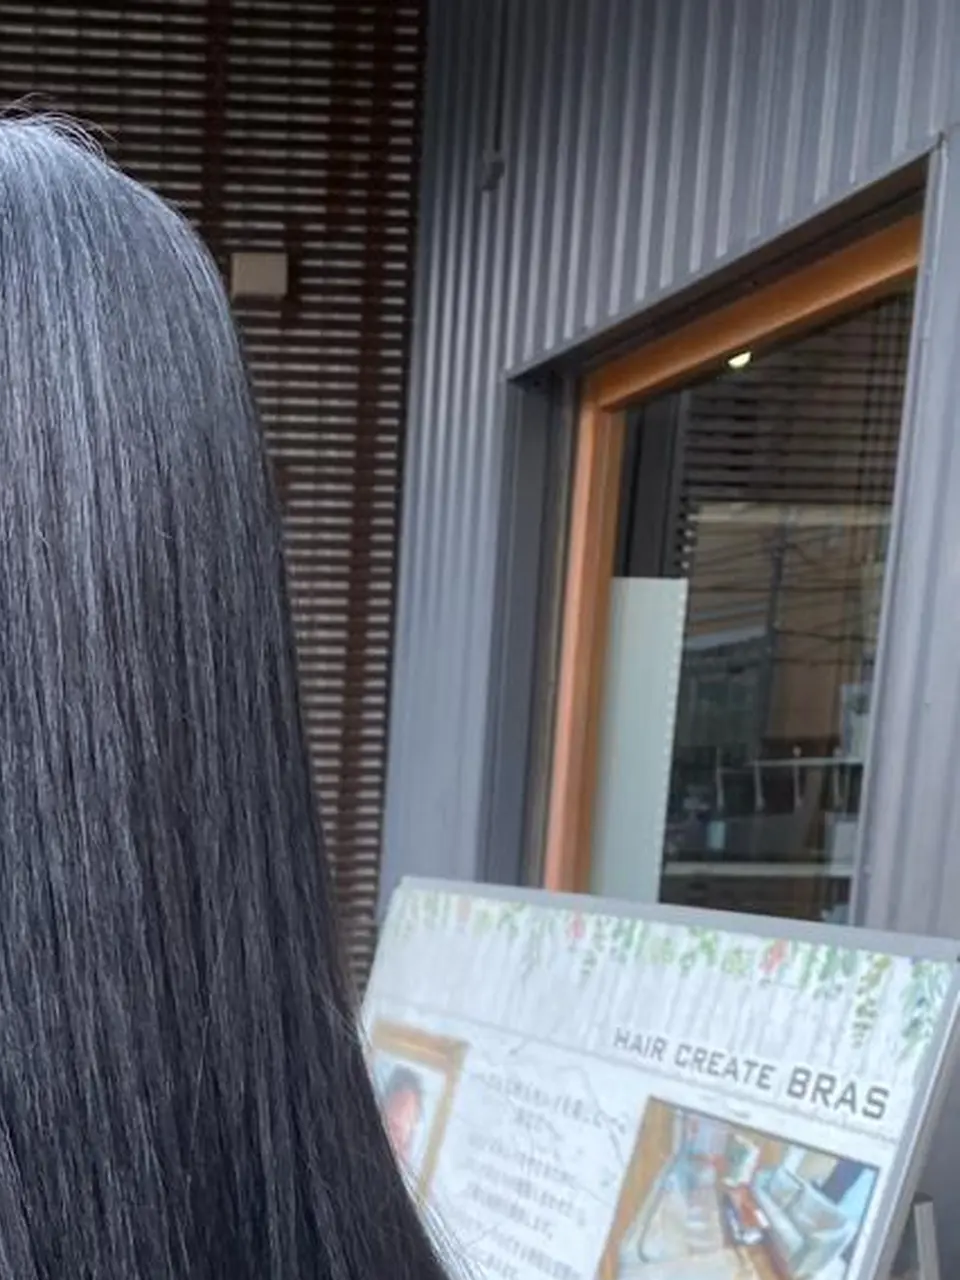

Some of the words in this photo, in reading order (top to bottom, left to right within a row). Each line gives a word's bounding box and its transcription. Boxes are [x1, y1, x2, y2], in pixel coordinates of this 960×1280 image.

[614, 1028, 666, 1062] HAIR
[675, 1044, 775, 1089] CREATE
[788, 1067, 889, 1119] BRAS
